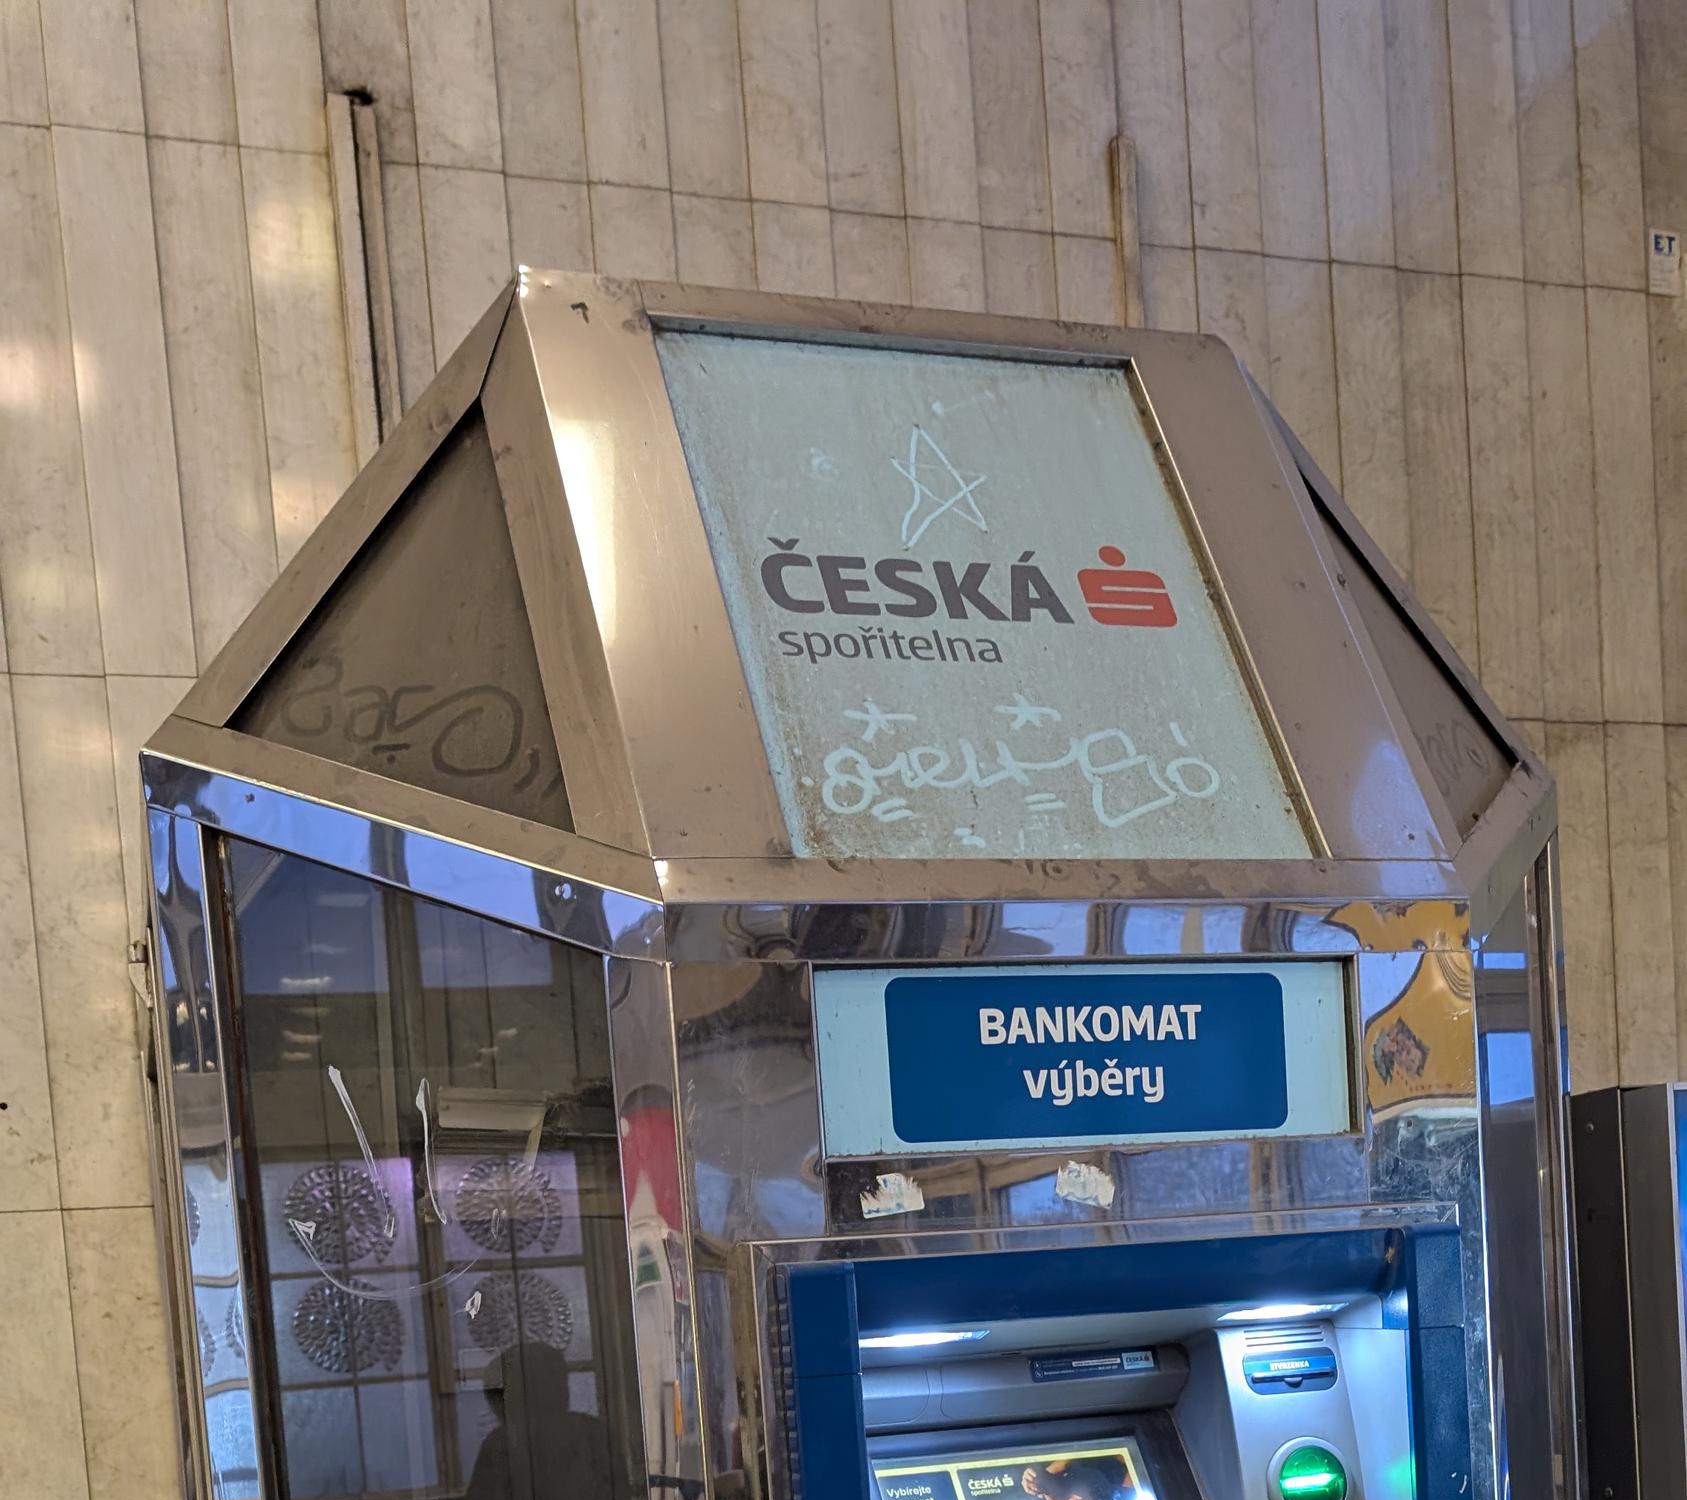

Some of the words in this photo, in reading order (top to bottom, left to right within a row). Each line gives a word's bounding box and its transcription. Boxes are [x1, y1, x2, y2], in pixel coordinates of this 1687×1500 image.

[761, 537, 1075, 624] ČESKÁ
[778, 626, 1004, 664] spořitelna
[979, 1003, 1202, 1045] BANKOMAT
[1023, 1059, 1165, 1106] výběry
[887, 1486, 931, 1498] Vybírejte
[968, 1477, 1002, 1490] ČESKÁ
